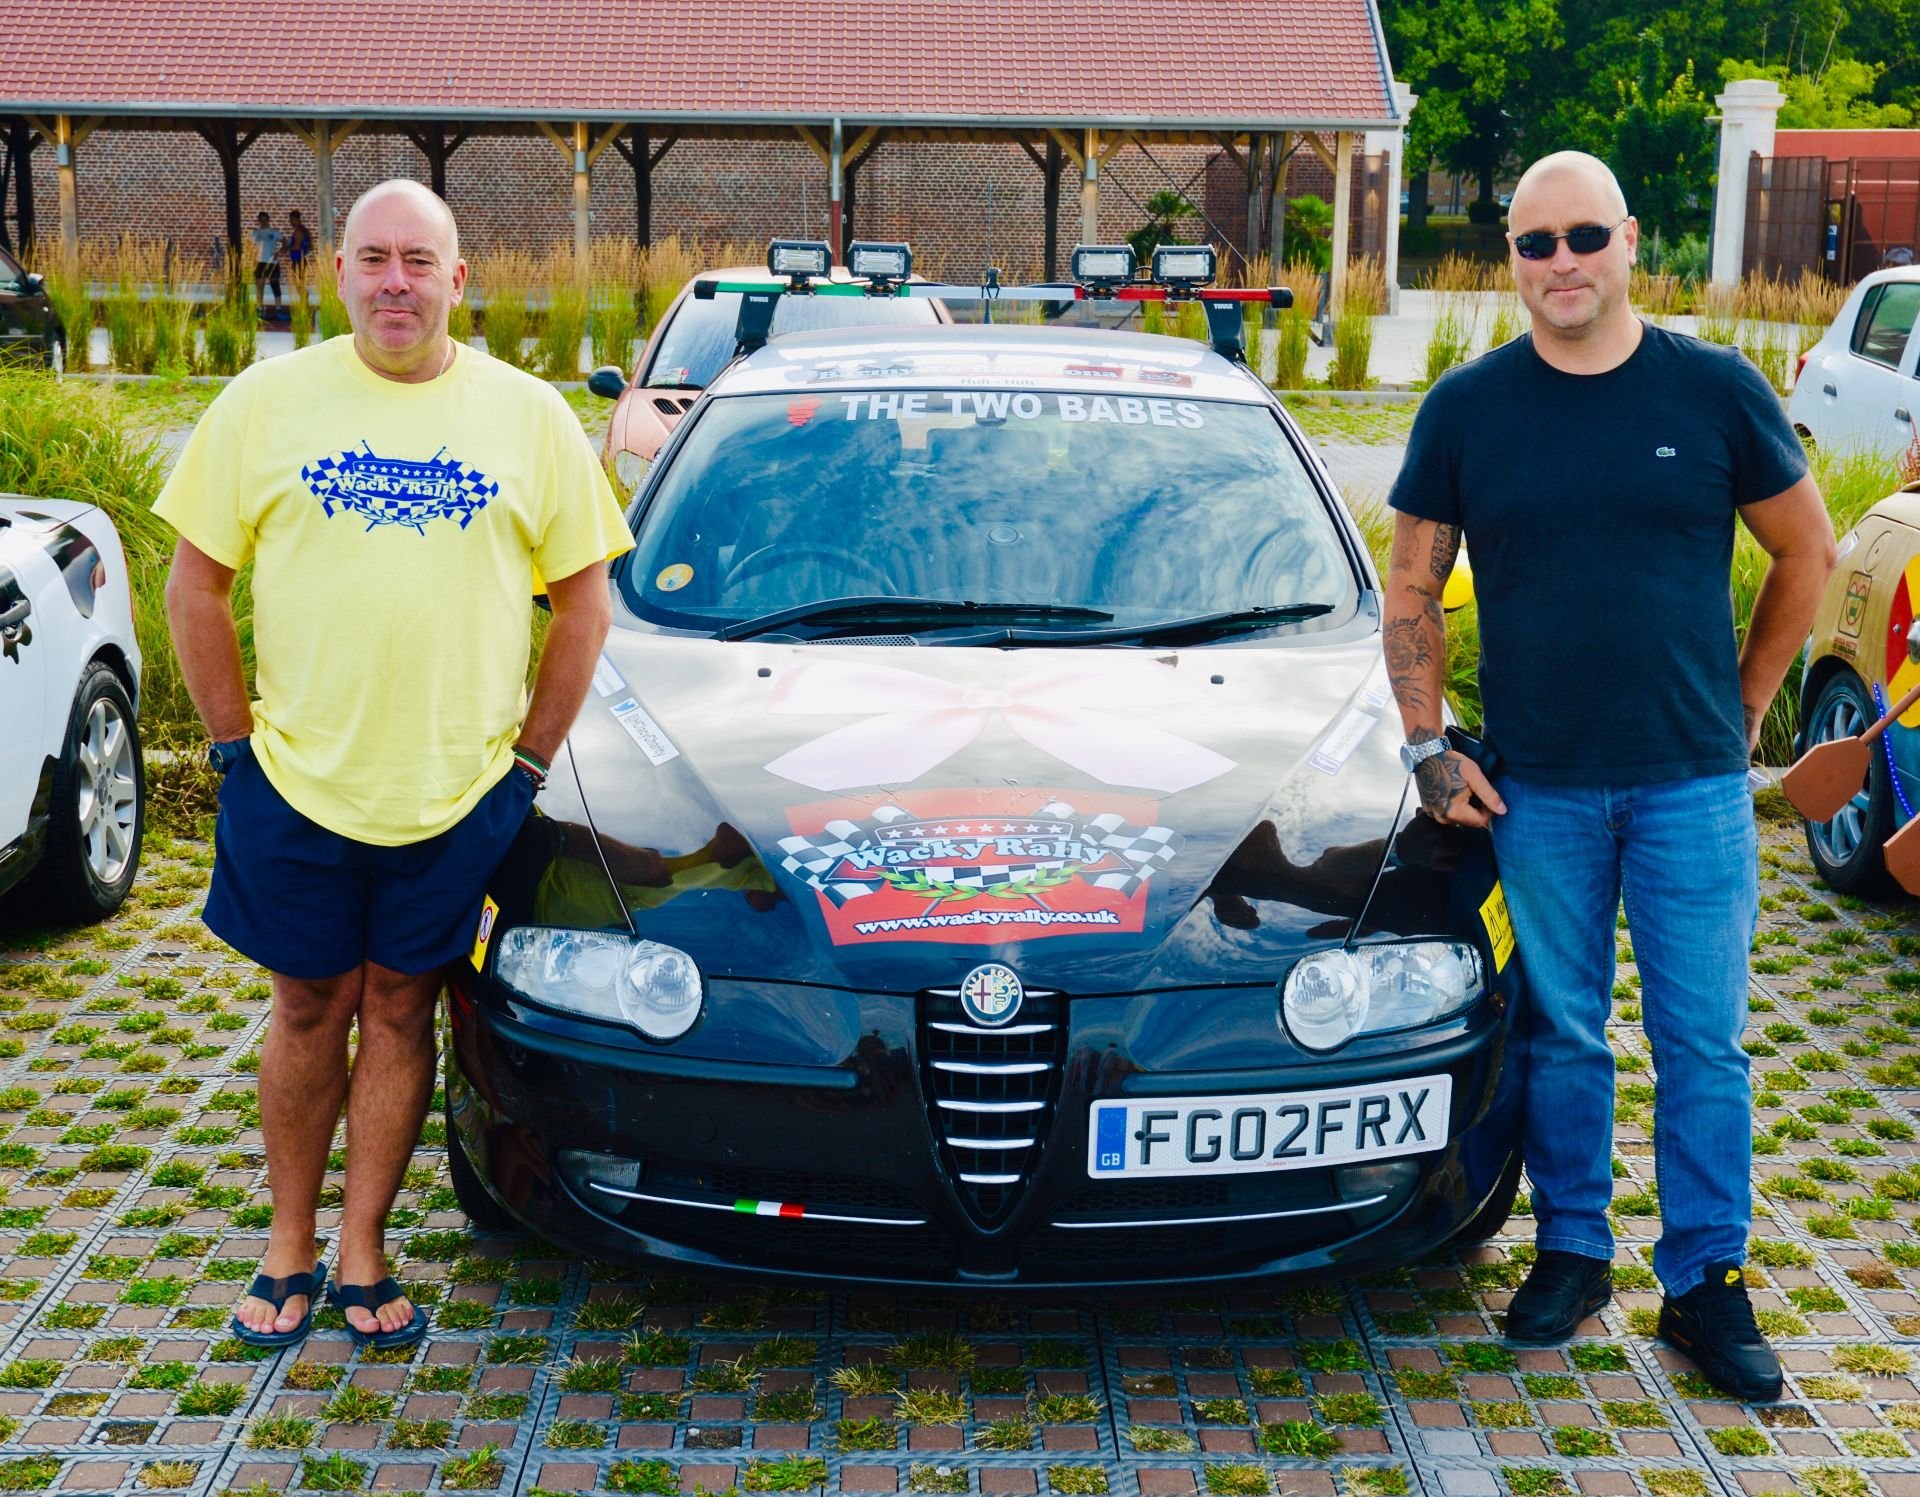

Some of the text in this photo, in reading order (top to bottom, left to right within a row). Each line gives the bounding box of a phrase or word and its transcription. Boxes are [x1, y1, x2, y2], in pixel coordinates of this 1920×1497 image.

[840, 392, 1205, 430] THE TWO BABES
[335, 475, 463, 503] Wacky Rally
[847, 836, 1110, 870] Wacky Rally
[853, 908, 1120, 936] www.wackyrally.co.uk
[966, 968, 1019, 996] ALFA ROMEO
[1101, 1152, 1121, 1167] GB
